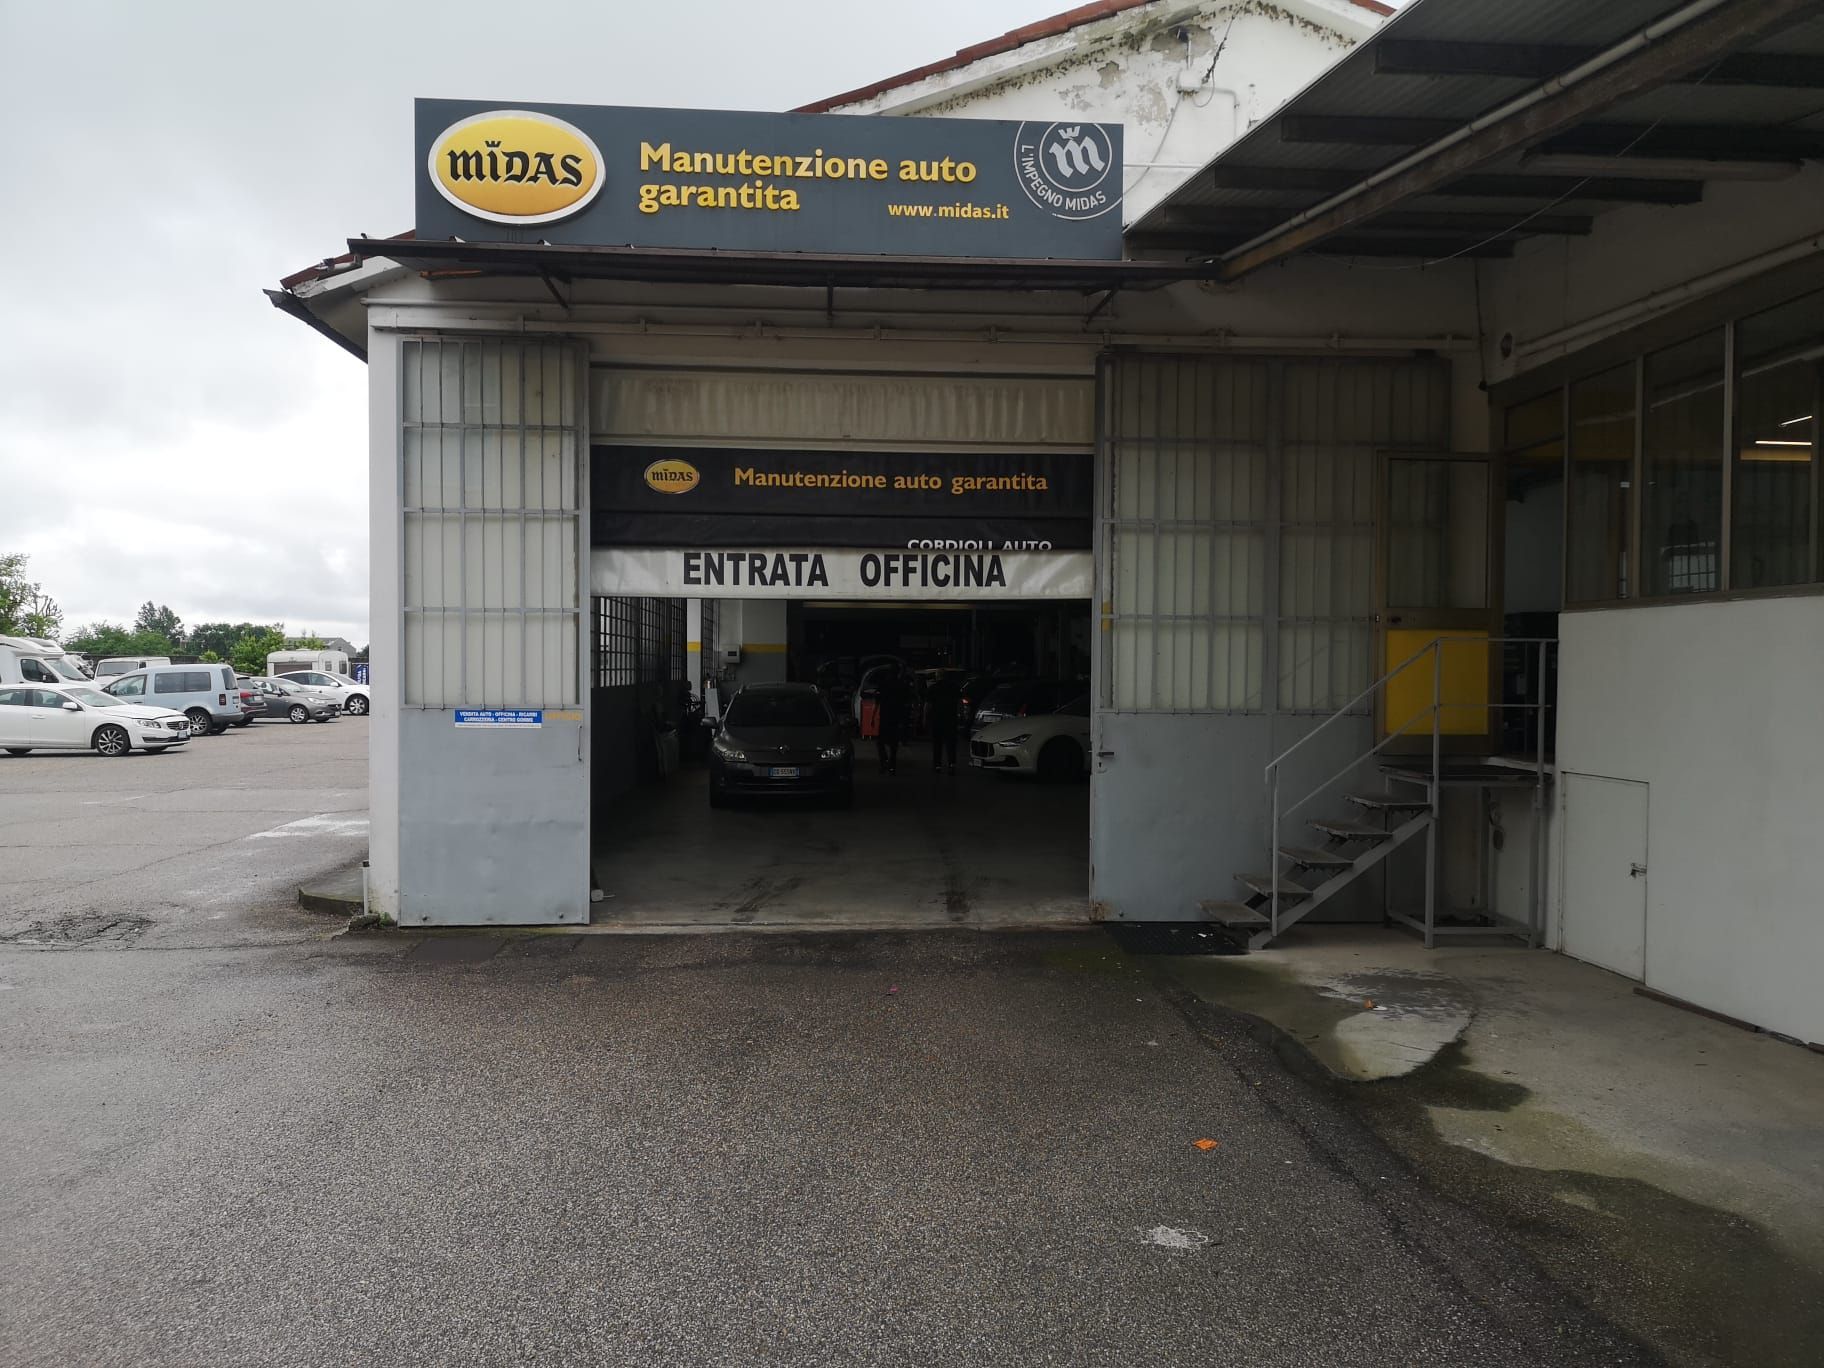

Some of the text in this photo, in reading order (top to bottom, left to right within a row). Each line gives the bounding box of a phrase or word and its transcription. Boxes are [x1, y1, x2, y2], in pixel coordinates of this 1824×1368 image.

[640, 142, 977, 183] Manutenzione auto
[1021, 144, 1106, 211] L'IMPEGNO MIDAS
[638, 179, 801, 214] garantita
[888, 203, 1009, 219] www.midas.it
[734, 467, 1049, 495] Manutenzione auto garantita
[1002, 541, 1052, 551] AUTO
[683, 552, 1007, 588] ENTRATA OFFICINA
